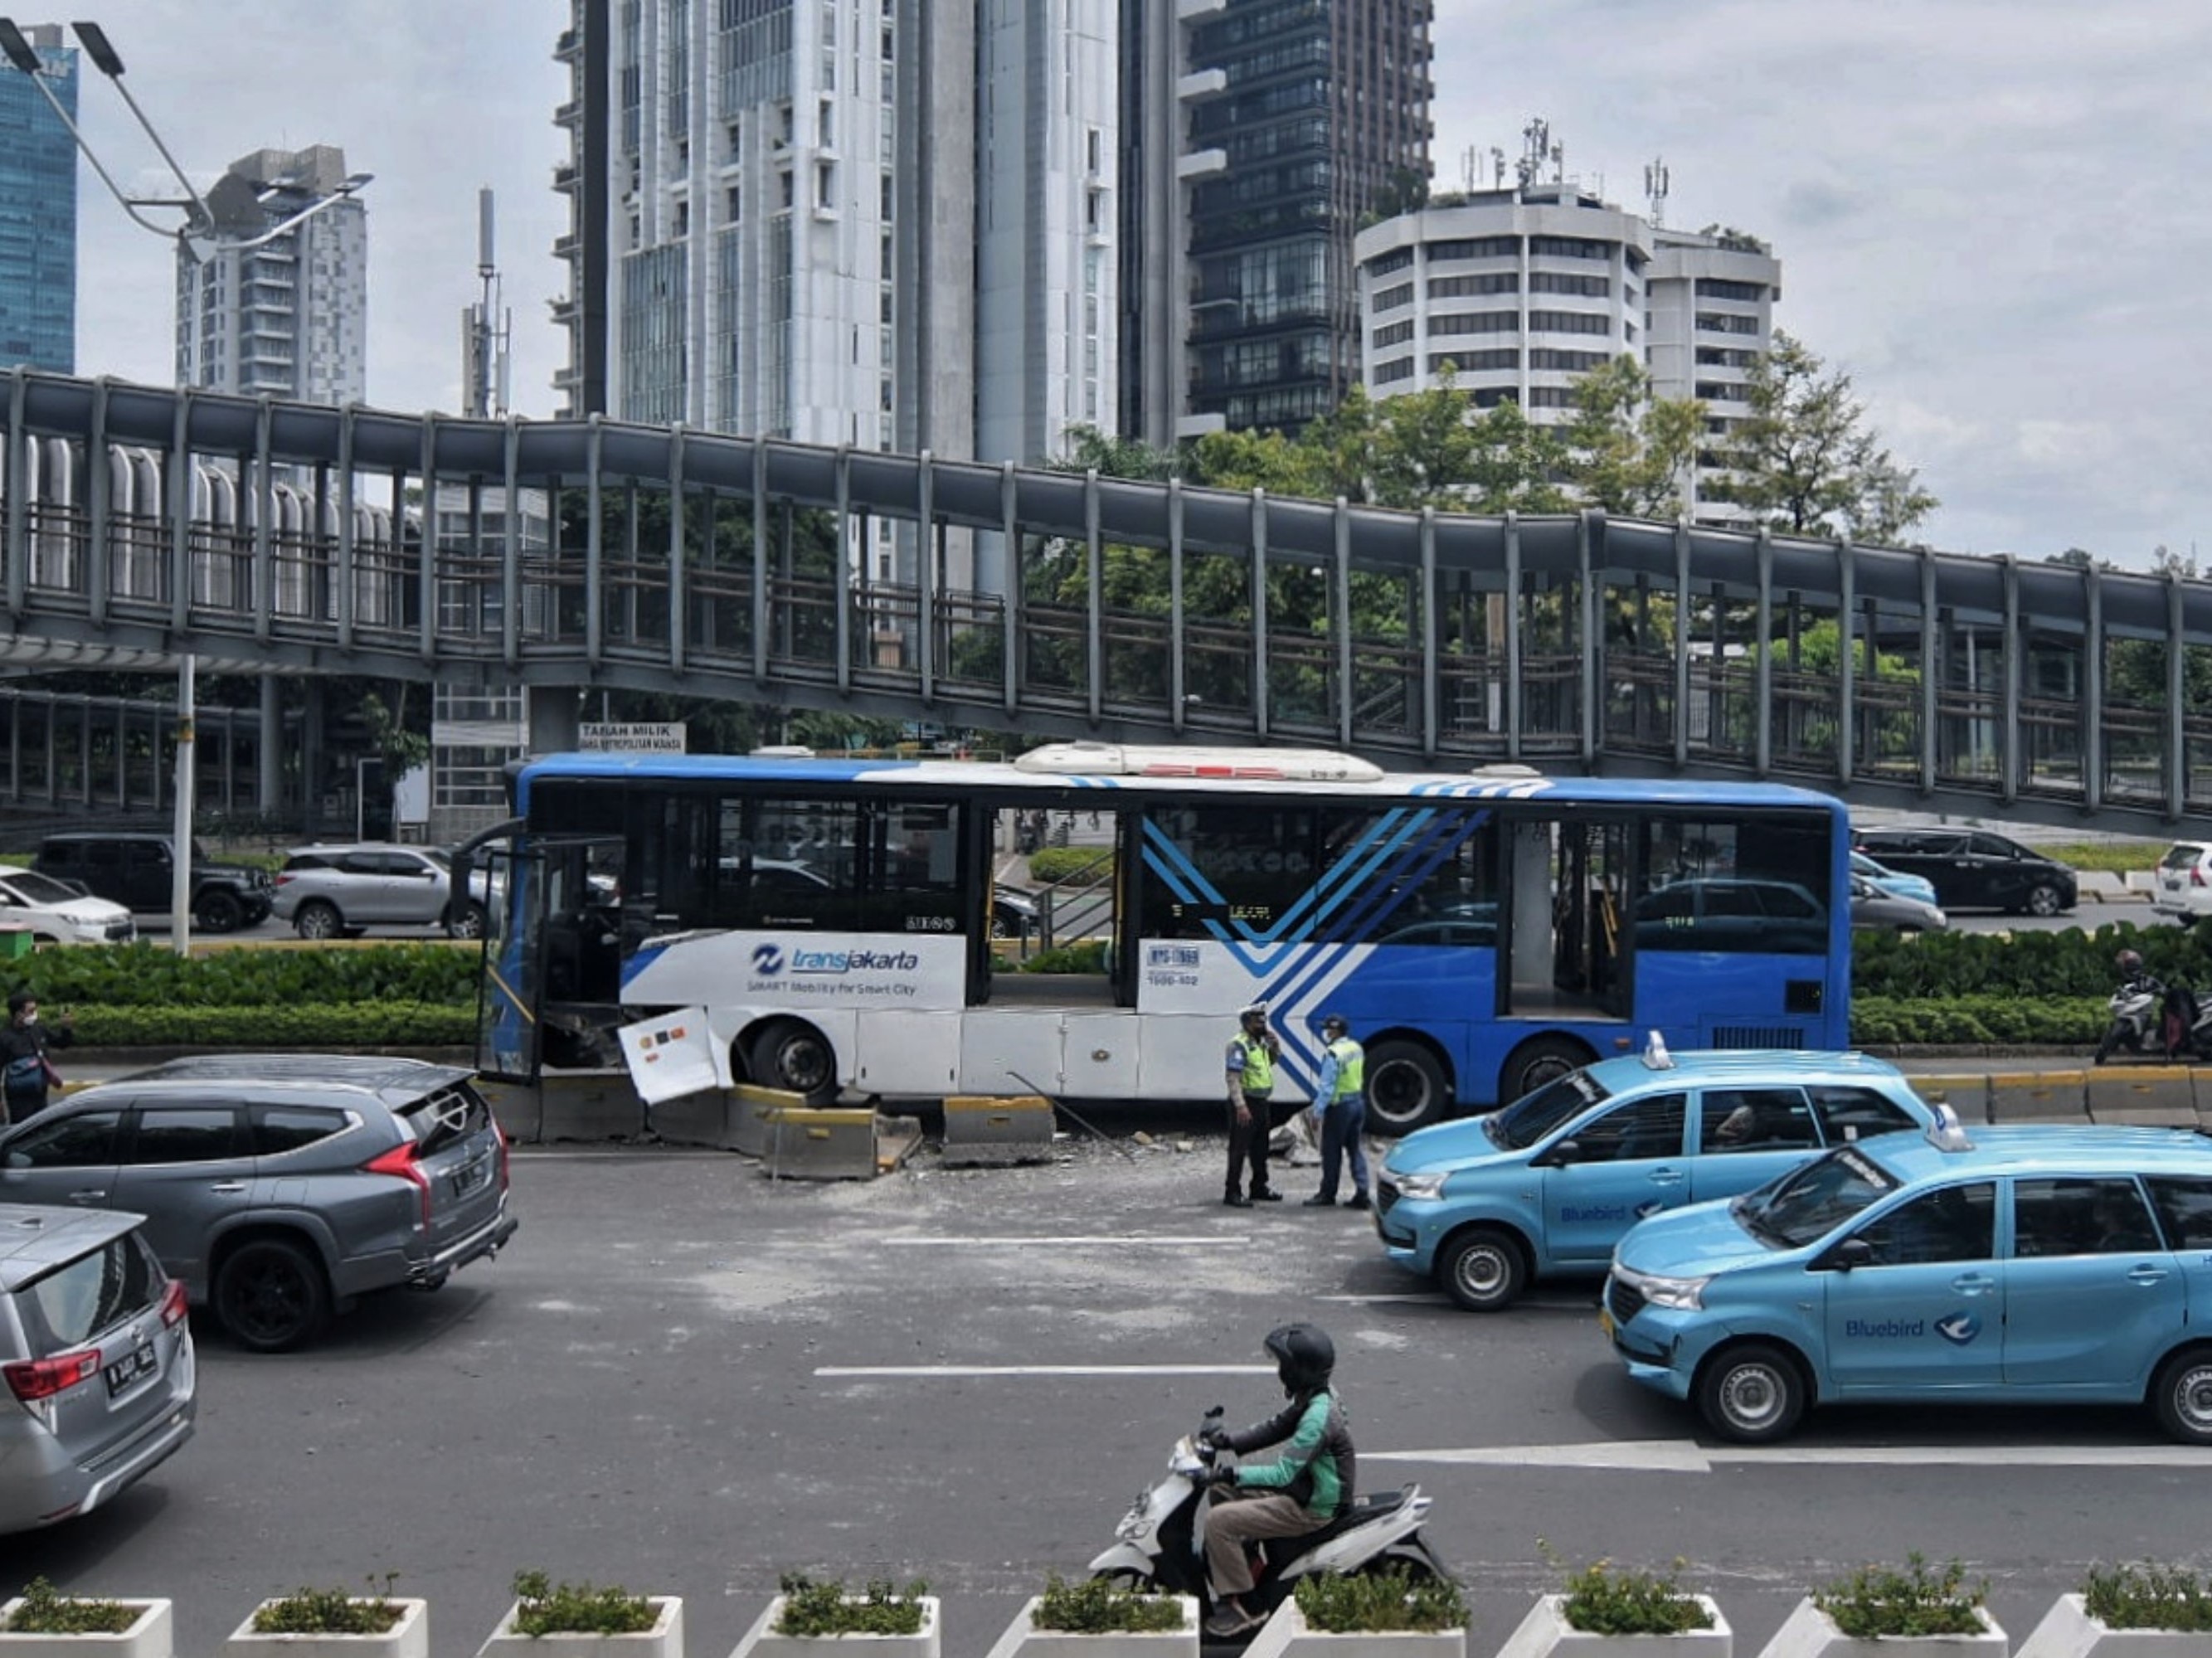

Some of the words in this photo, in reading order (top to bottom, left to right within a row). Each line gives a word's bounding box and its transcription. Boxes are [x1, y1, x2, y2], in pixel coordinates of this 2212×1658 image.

[632, 725, 670, 737] MILIK
[791, 949, 918, 974] transjakarta
[790, 981, 835, 995] Mobility
[839, 983, 854, 994] for
[858, 983, 890, 994] Smart
[893, 984, 916, 996] City
[1846, 1319, 1924, 1337] Bluebird
